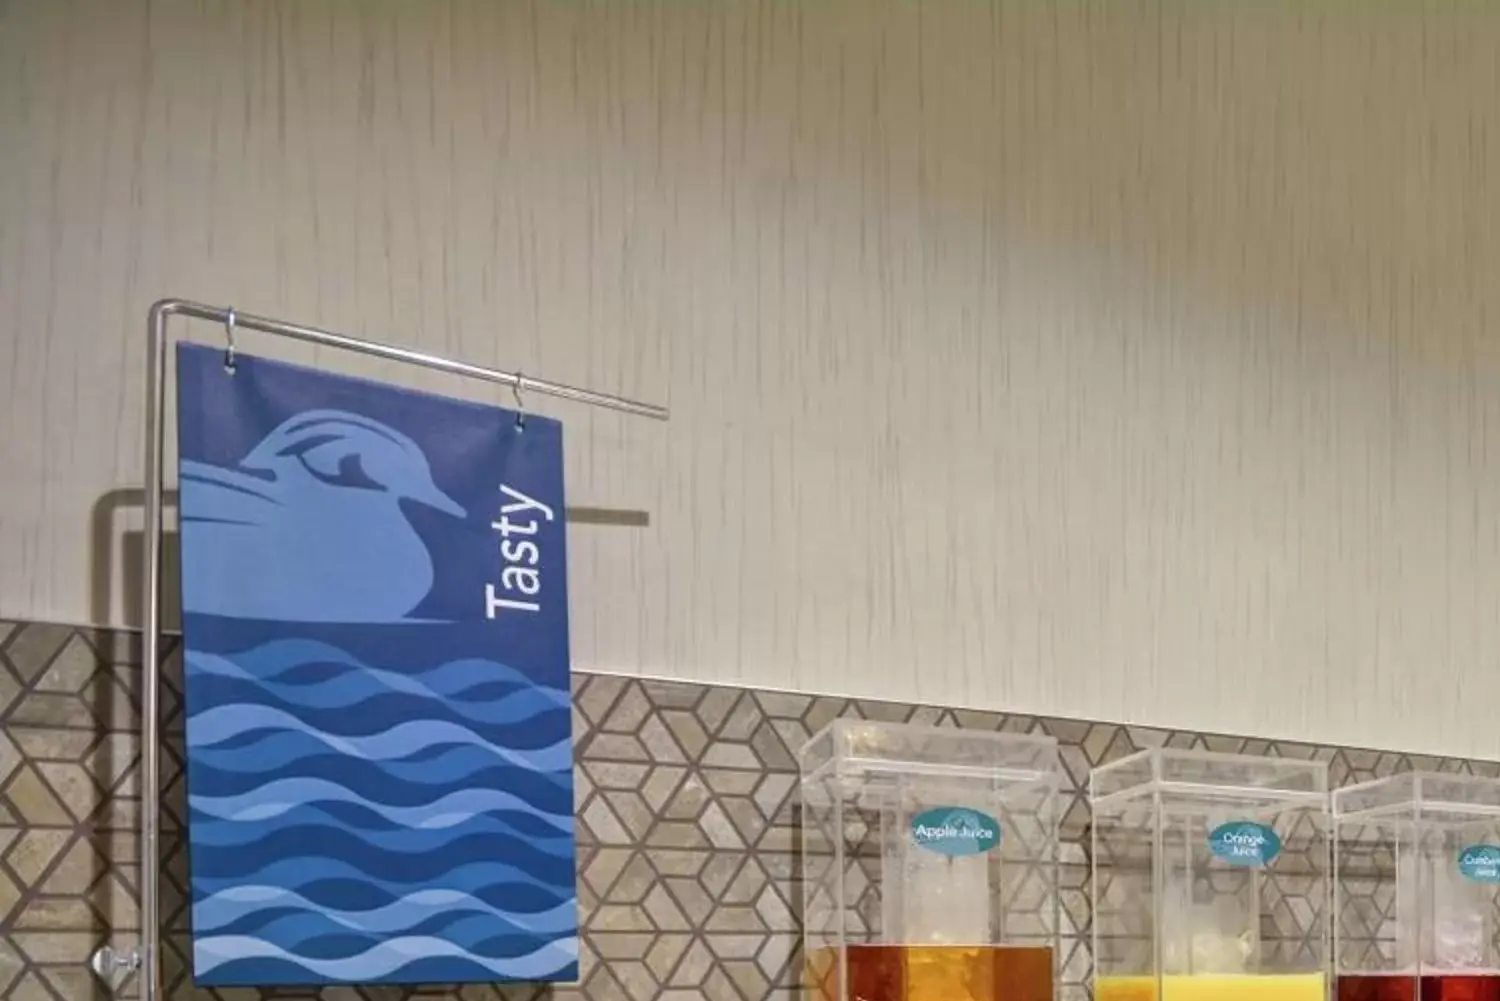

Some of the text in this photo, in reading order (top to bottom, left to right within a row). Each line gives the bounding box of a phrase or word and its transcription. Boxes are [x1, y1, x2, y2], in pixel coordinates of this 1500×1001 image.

[486, 483, 554, 620] Tasty
[915, 823, 993, 841] Apple Juice
[1223, 831, 1266, 848] Orange
